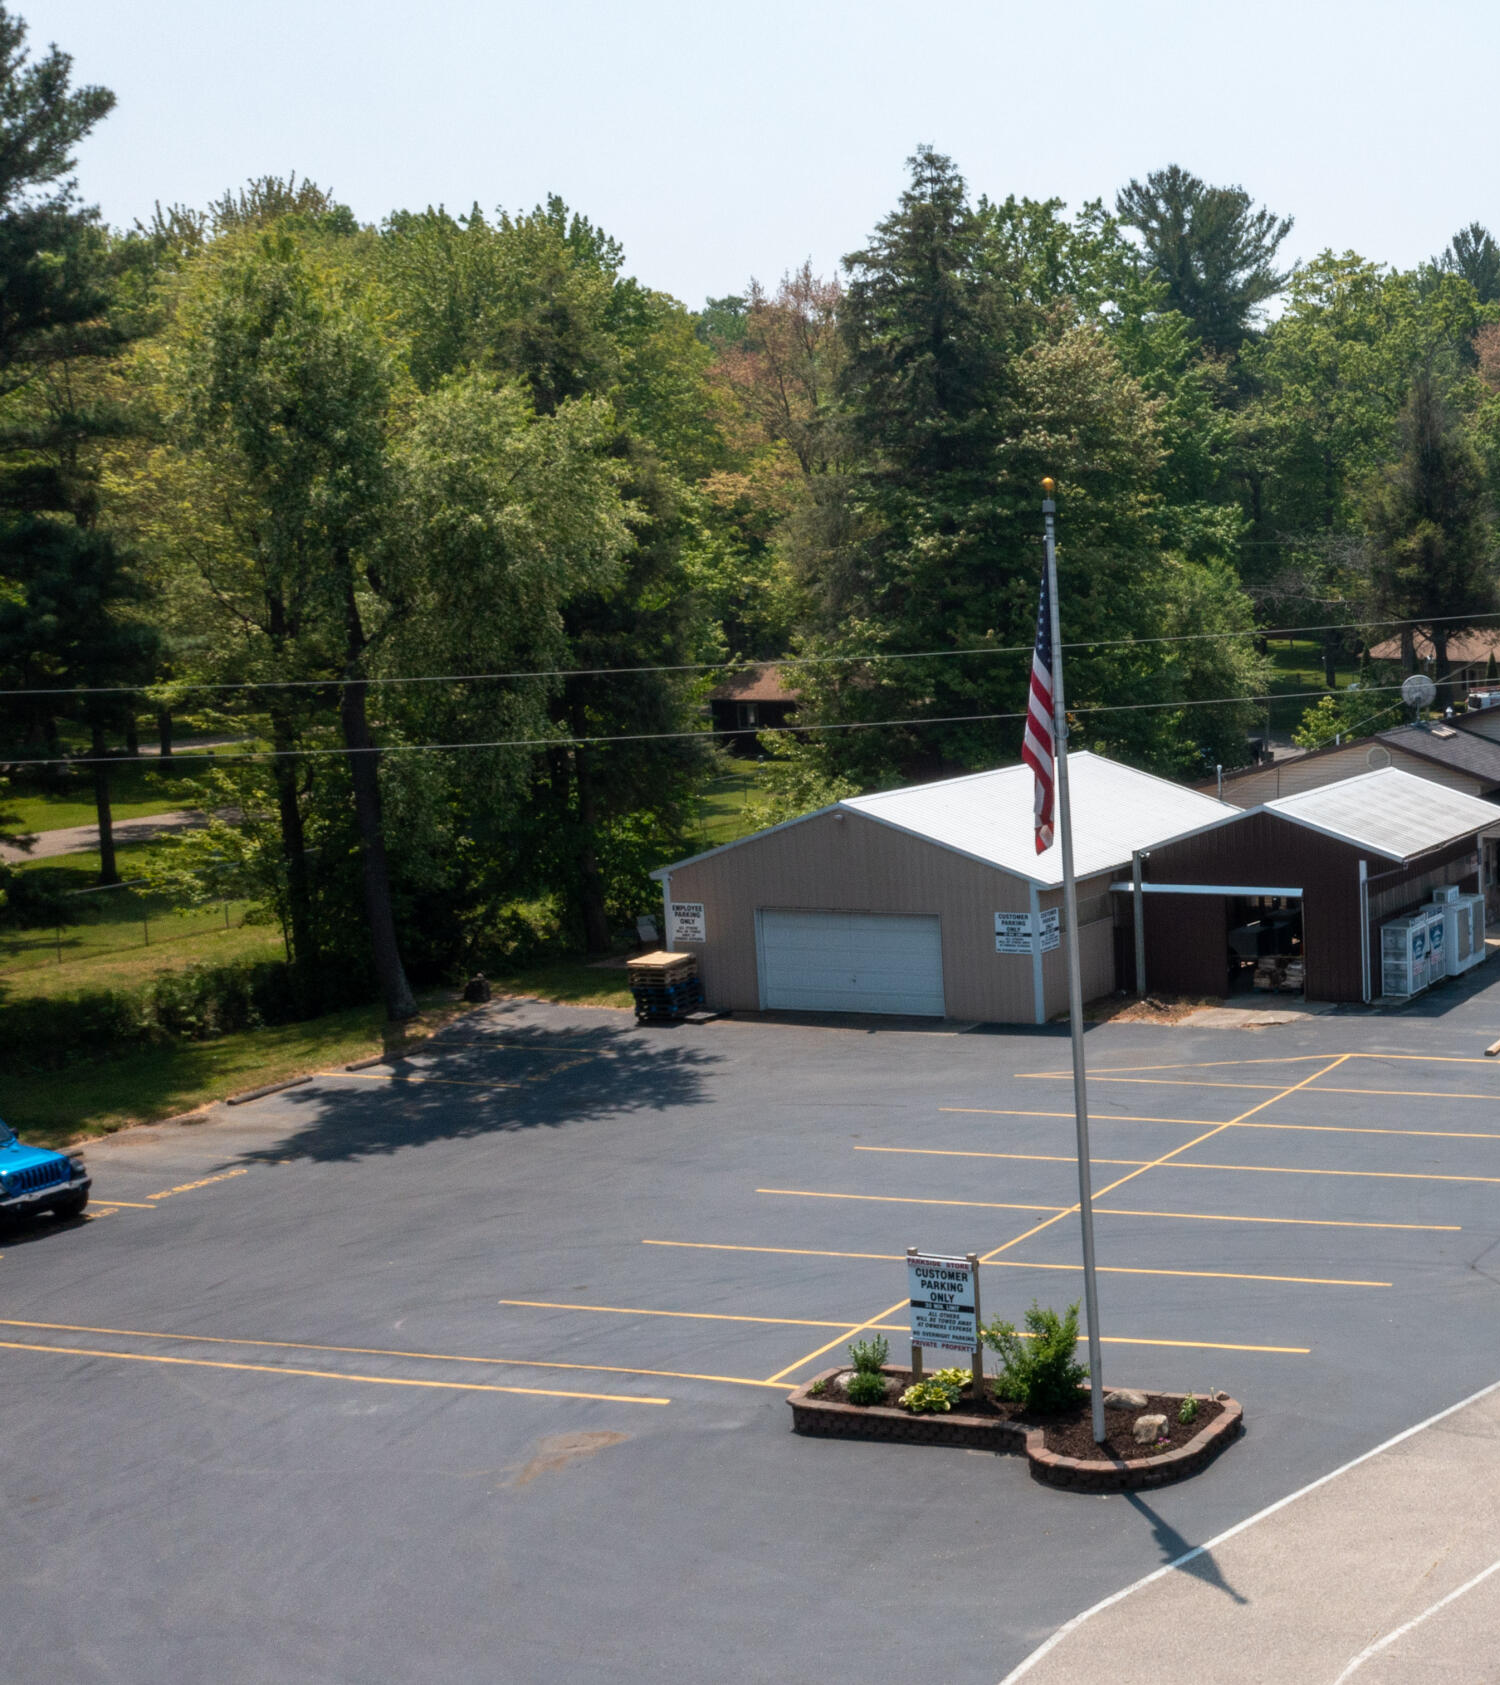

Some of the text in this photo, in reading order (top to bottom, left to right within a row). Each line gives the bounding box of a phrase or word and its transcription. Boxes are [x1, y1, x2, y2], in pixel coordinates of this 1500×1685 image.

[907, 1258, 969, 1270] PARKSIDE STORE
[915, 1268, 968, 1282] CUSTOMER
[921, 1280, 964, 1293] PARKING
[930, 1292, 955, 1303] ONLY
[912, 1340, 975, 1352] PRIVATE PROPERTY
